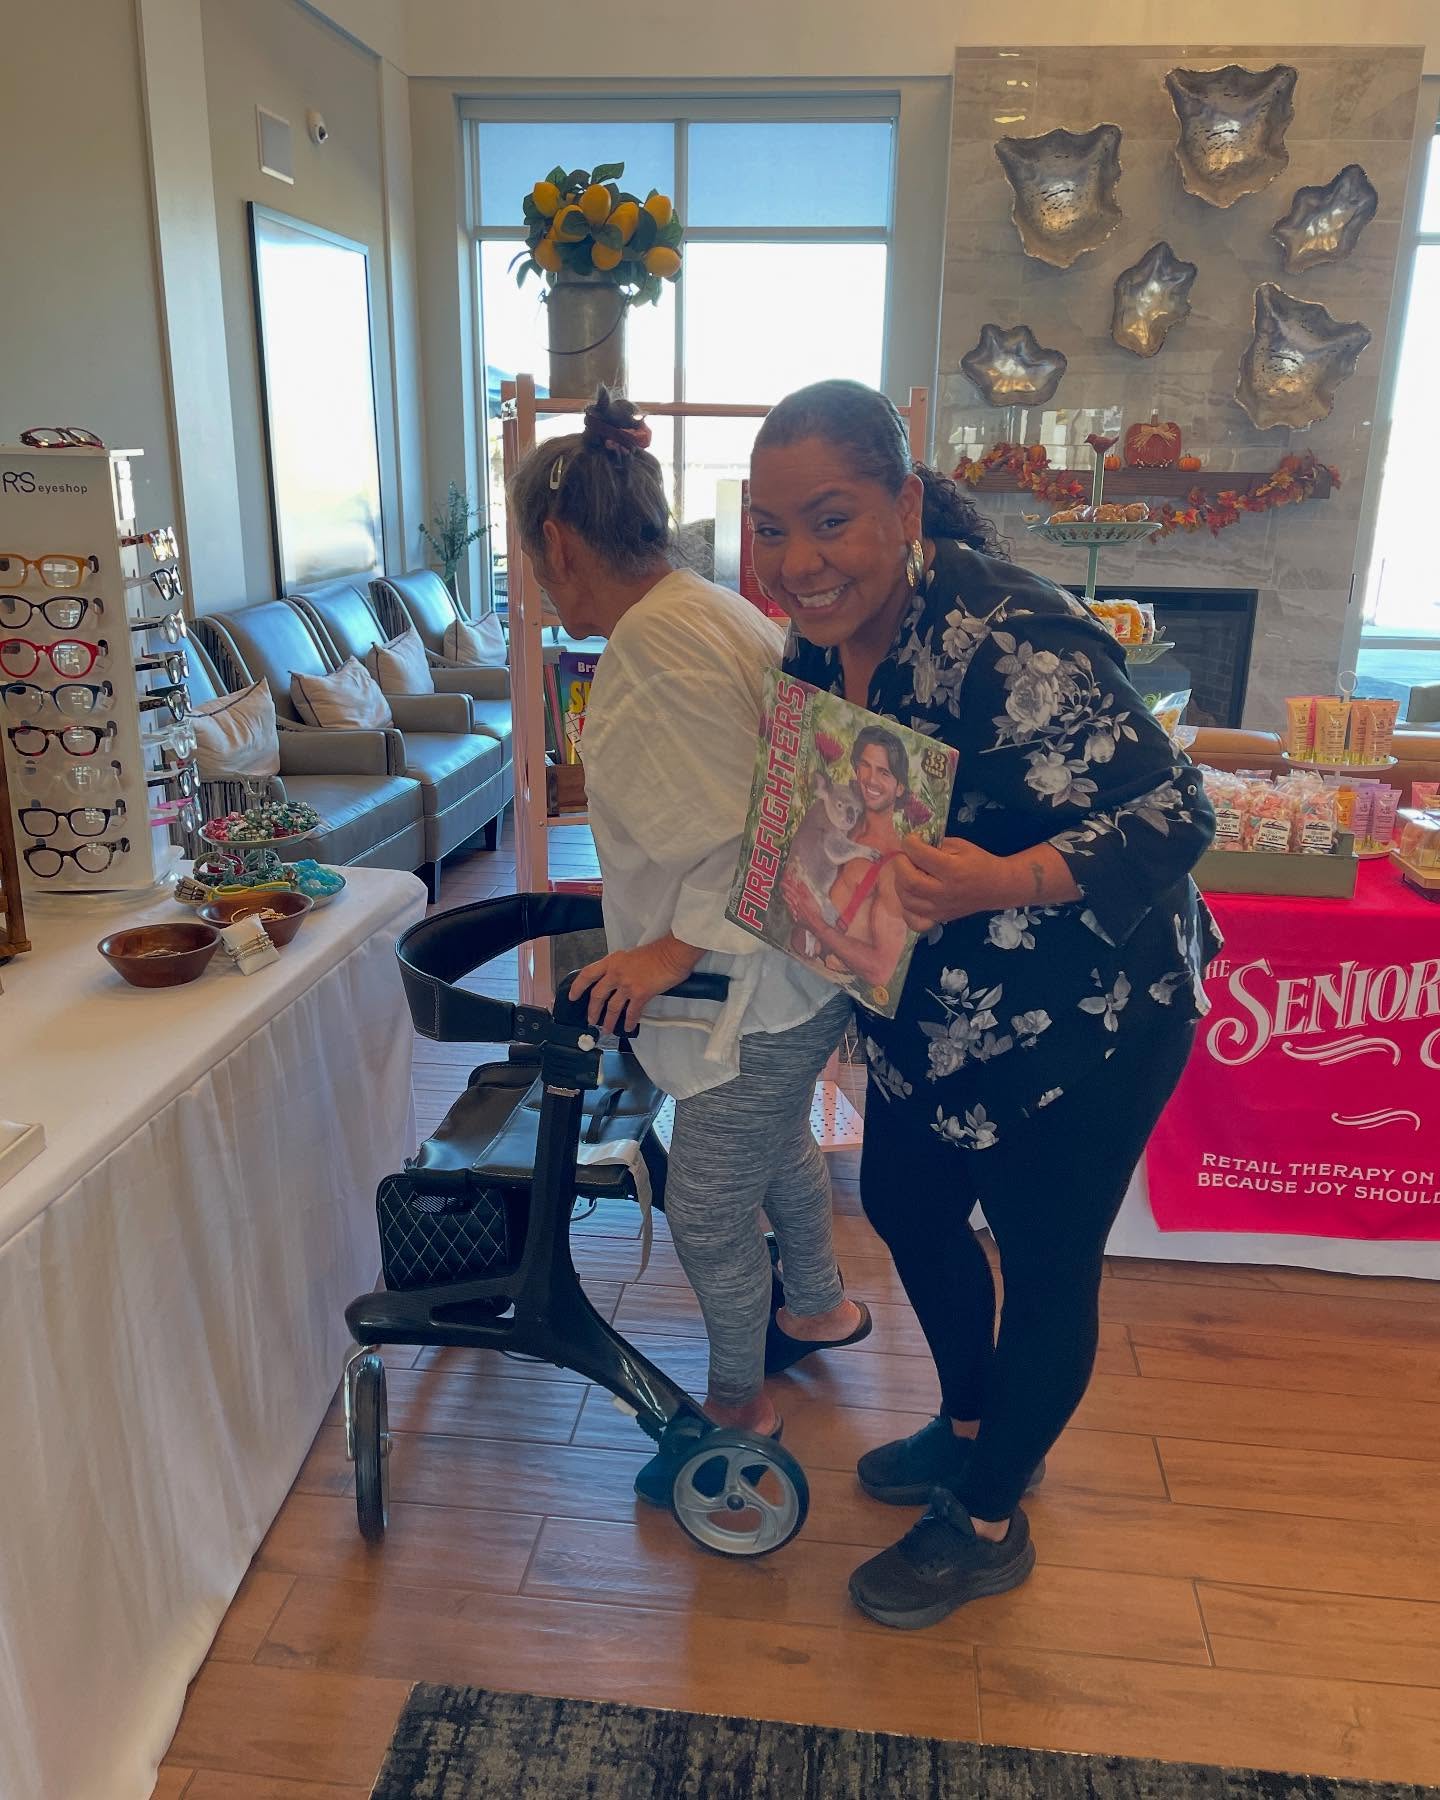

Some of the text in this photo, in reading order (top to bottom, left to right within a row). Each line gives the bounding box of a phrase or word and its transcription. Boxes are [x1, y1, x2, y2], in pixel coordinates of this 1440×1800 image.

[2, 471, 88, 495] RS eyeshop
[925, 750, 946, 772] 33
[738, 680, 806, 930] FIREFIGHTERS
[1205, 959, 1231, 980] HE
[1207, 957, 1440, 1066] SENIOR
[1202, 1152, 1434, 1185] RETAIL THERAPY ON
[1198, 1172, 1298, 1194] BECAUSE
[1304, 1181, 1348, 1196] JOY
